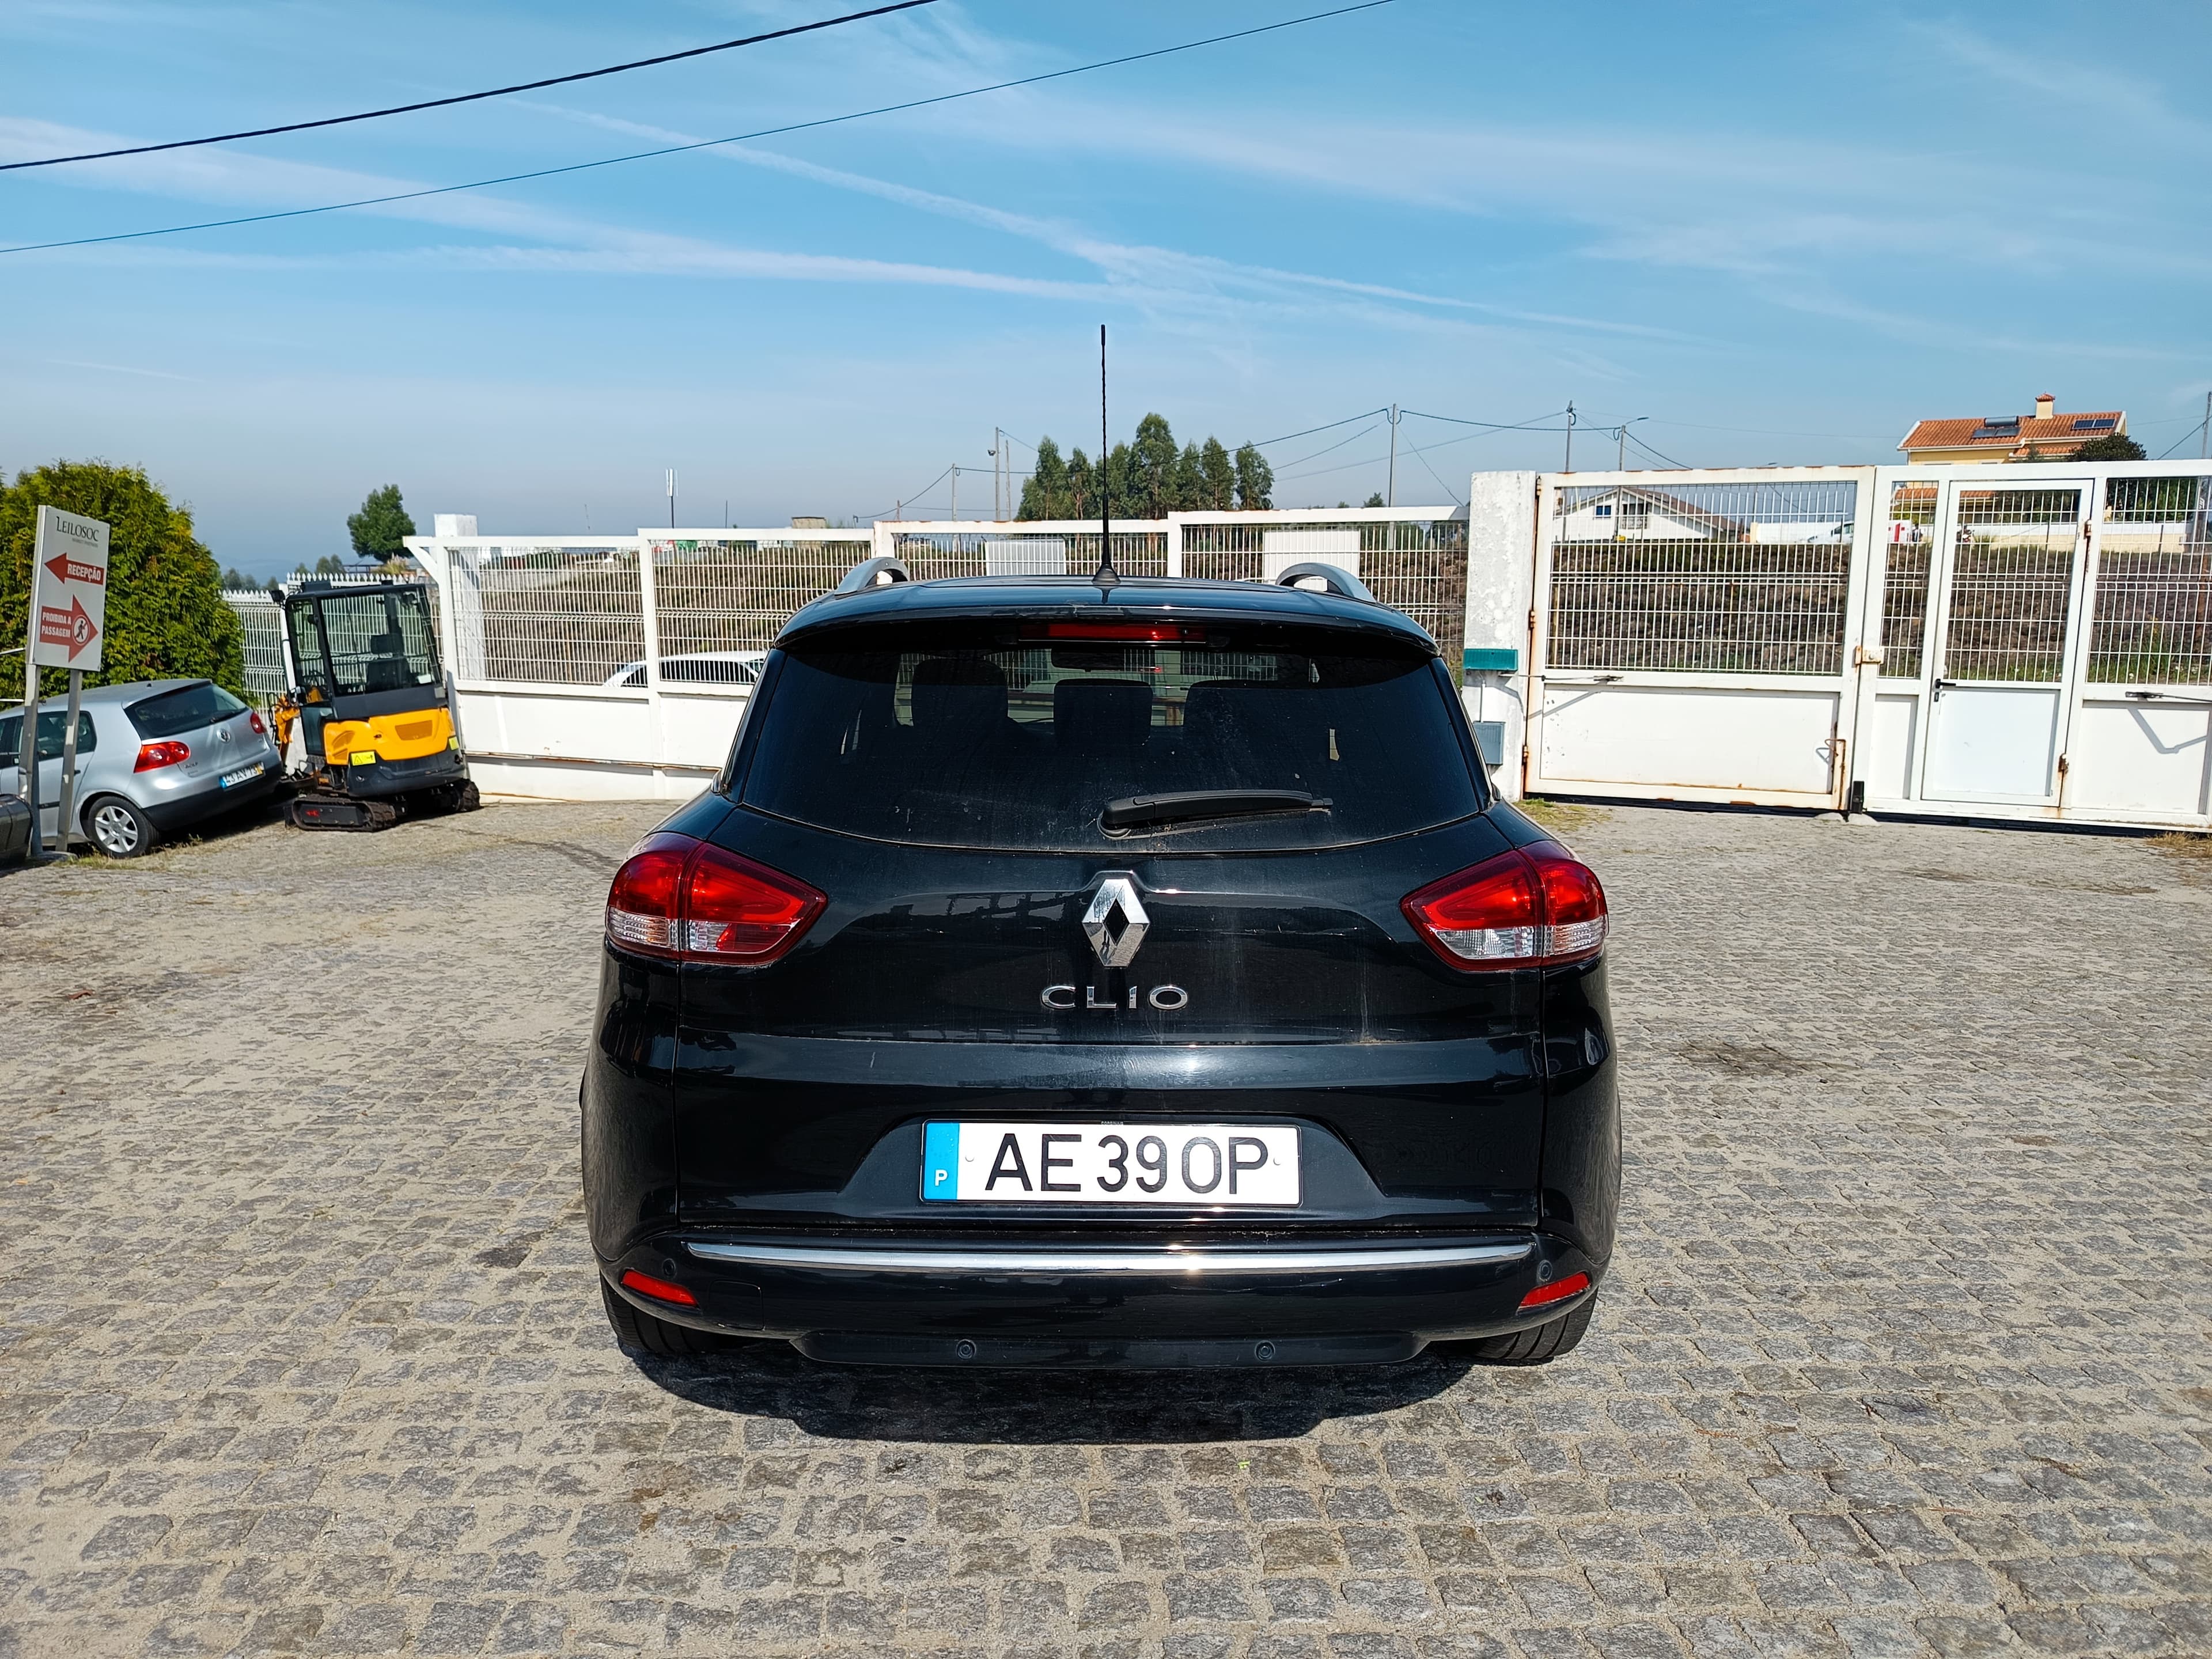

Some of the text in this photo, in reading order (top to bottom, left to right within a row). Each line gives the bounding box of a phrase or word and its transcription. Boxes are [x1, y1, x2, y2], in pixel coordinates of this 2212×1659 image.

[56, 516, 99, 541] LEILOSOC
[67, 563, 101, 582] RECEPÇÃO
[43, 611, 71, 625] PROIBIDA A
[41, 625, 71, 638] PASSAGEM
[1041, 986, 1188, 1010] CLIO
[984, 1133, 1082, 1192] AE
[1097, 1134, 1167, 1193] 39
[934, 1169, 948, 1187] P
